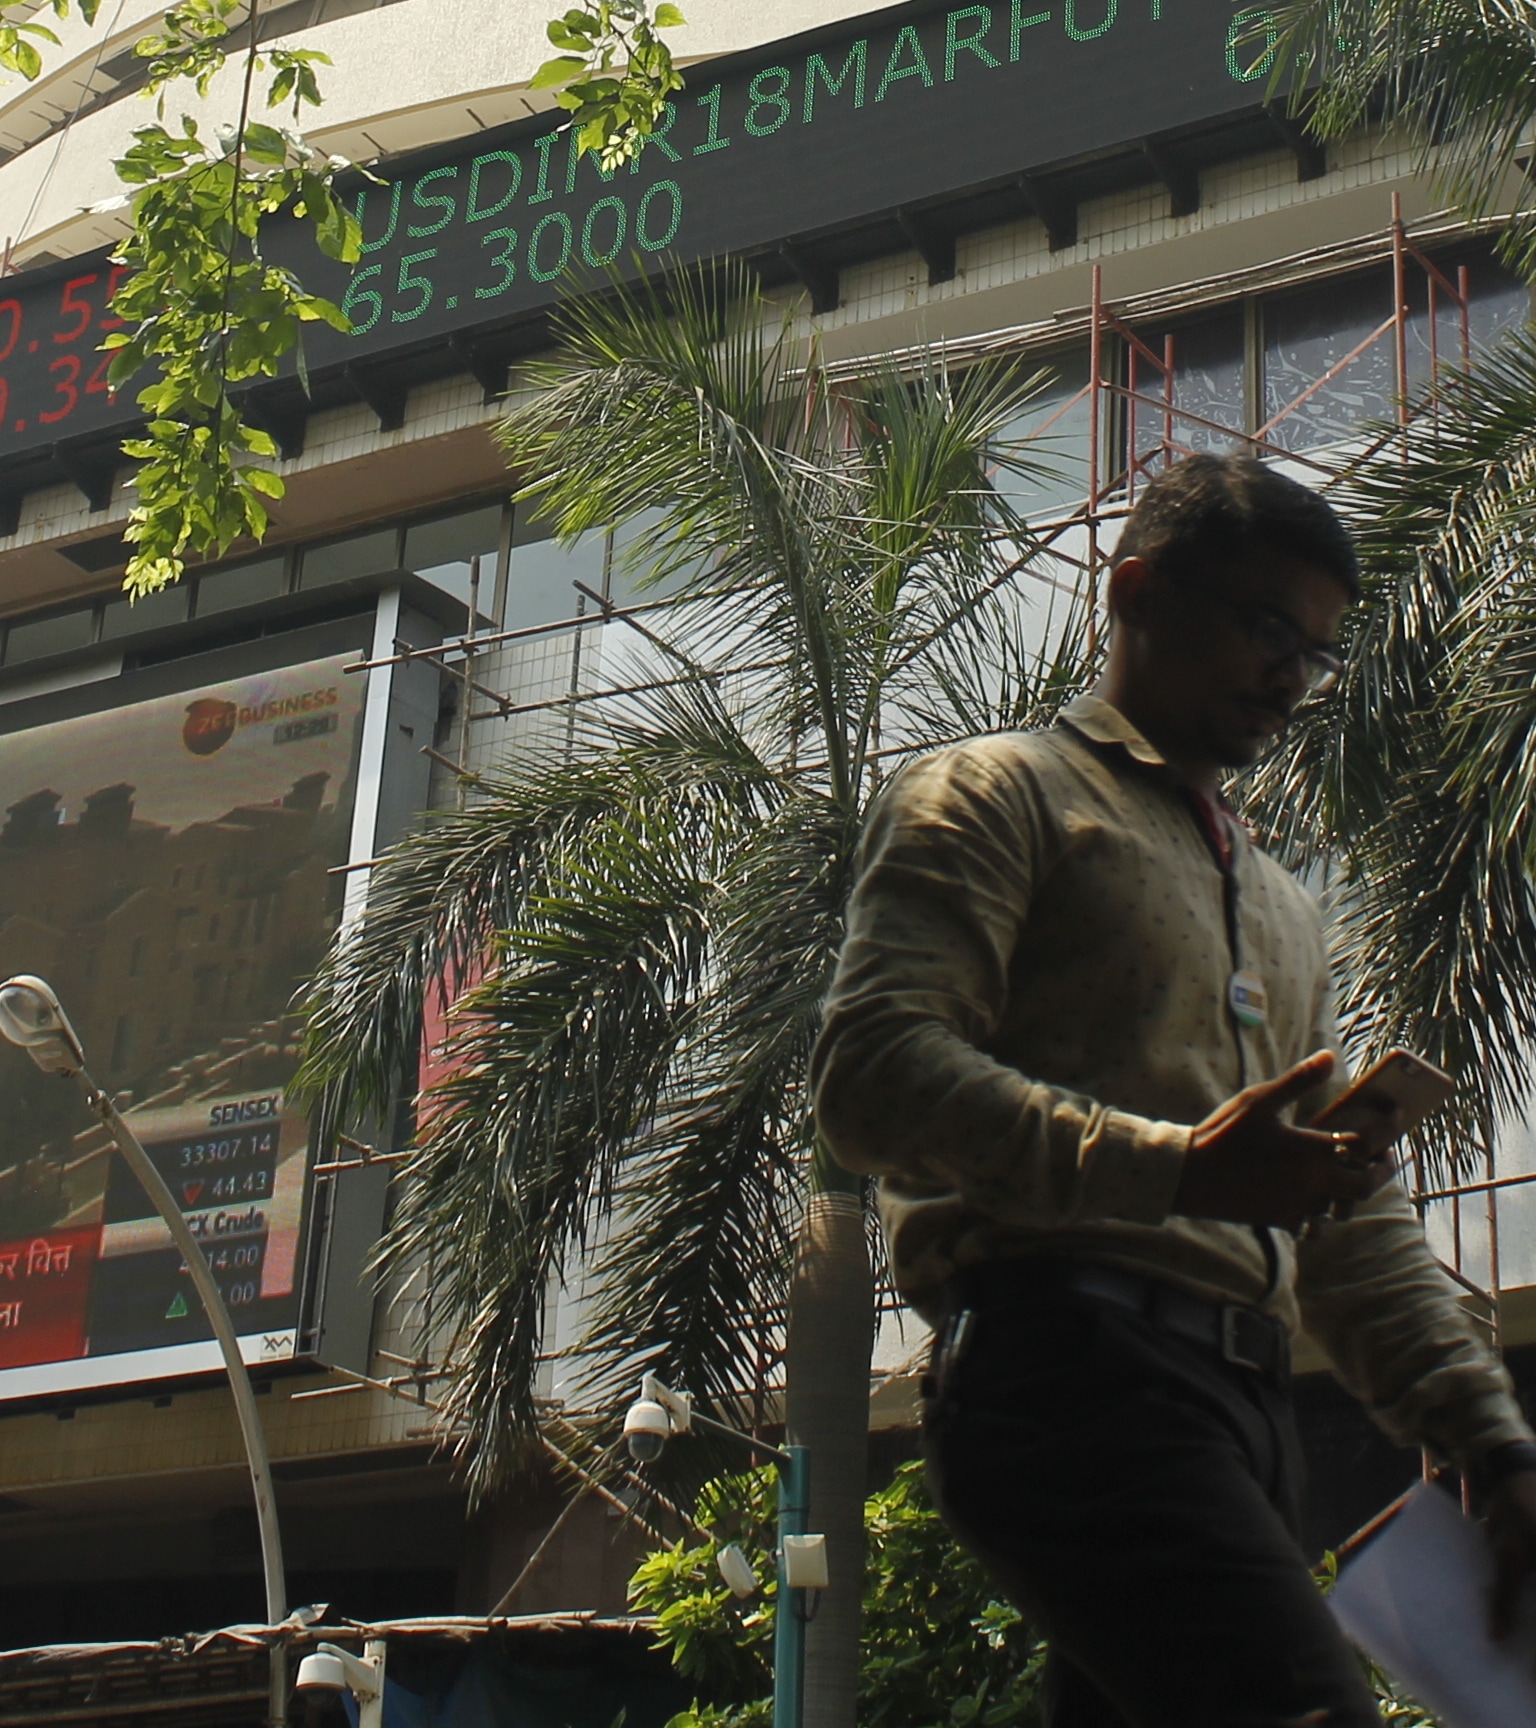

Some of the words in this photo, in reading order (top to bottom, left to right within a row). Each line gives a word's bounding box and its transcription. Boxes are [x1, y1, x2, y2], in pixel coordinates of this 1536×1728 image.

[341, 179, 684, 335] 65.3000
[238, 686, 339, 727] BUSINESS
[209, 1095, 280, 1127] SENSEX
[179, 1132, 272, 1168] 33307.14
[210, 1171, 267, 1199] 44.43
[214, 1205, 265, 1234] Crude
